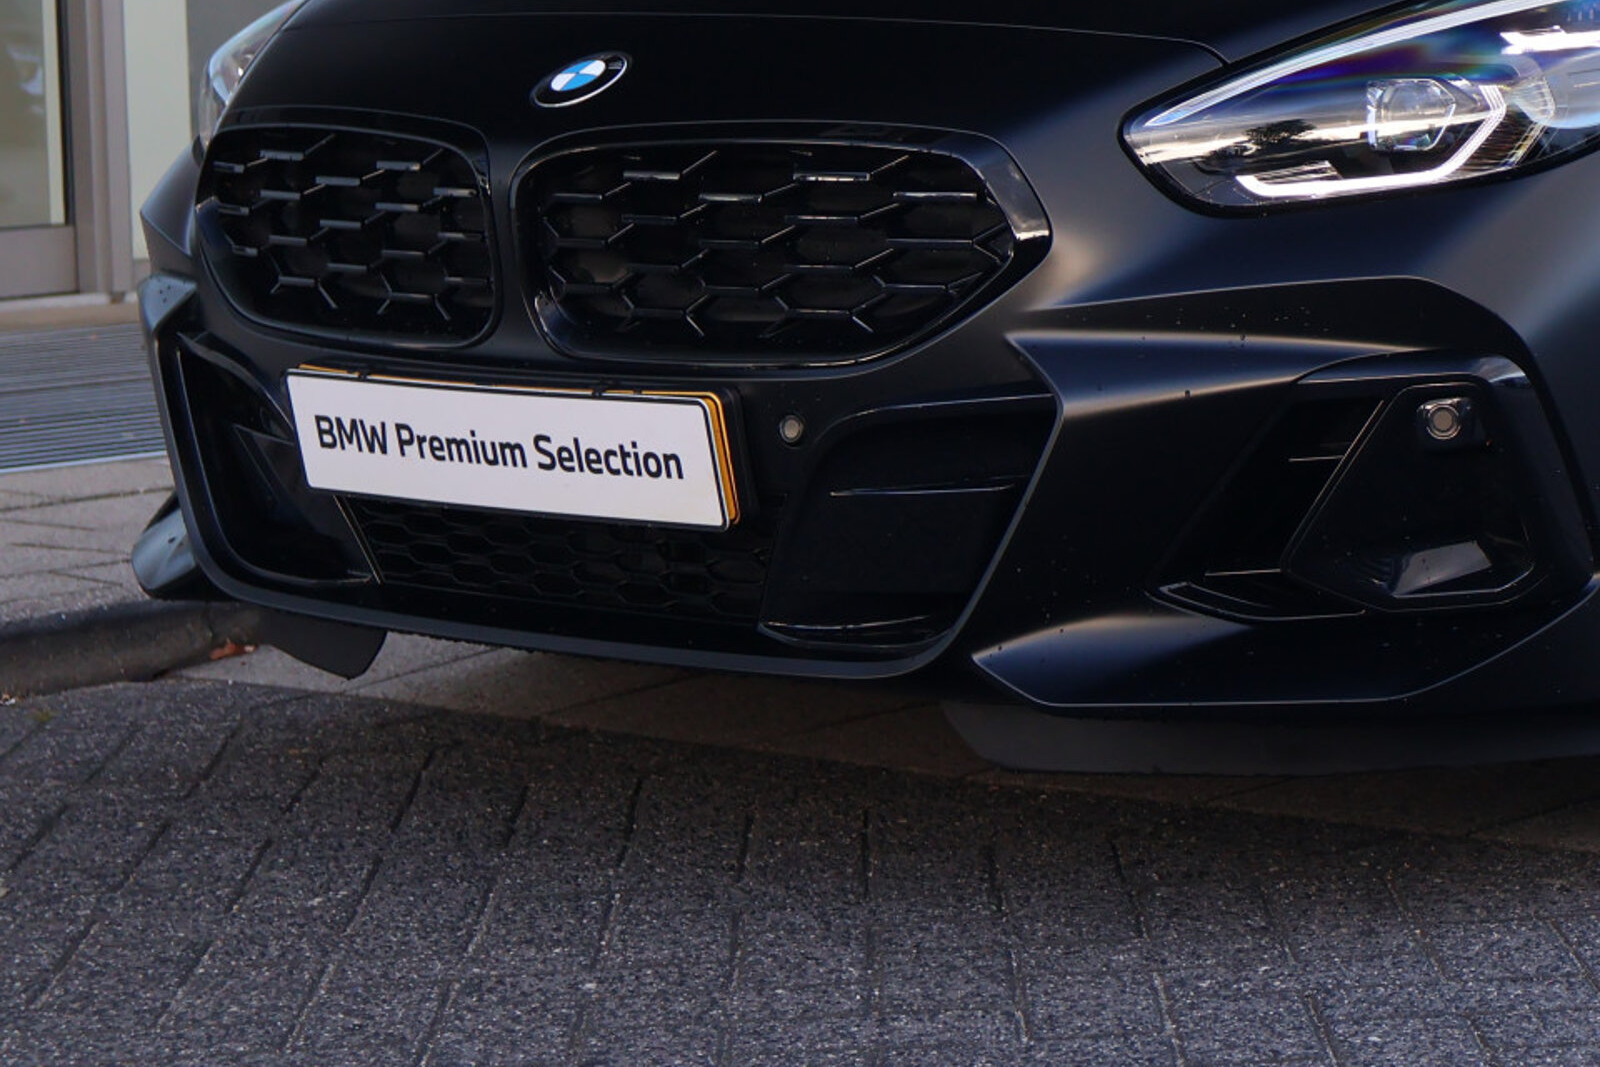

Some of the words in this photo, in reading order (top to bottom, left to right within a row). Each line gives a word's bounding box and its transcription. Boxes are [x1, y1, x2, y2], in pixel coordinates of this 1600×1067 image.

[314, 414, 388, 456] BMW
[395, 422, 528, 468] Premium
[533, 434, 684, 480] Selection
